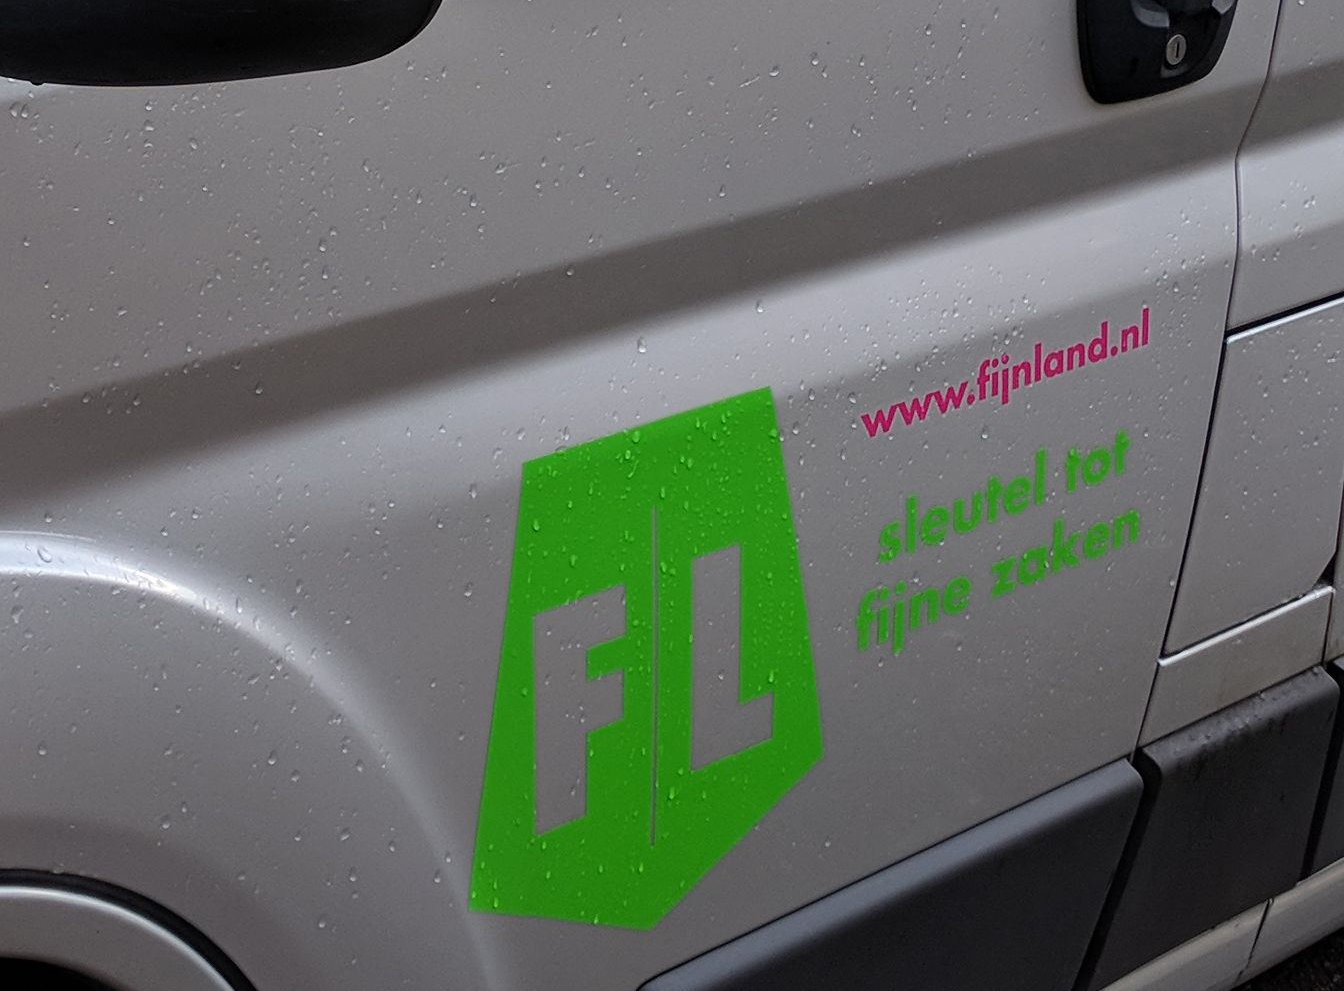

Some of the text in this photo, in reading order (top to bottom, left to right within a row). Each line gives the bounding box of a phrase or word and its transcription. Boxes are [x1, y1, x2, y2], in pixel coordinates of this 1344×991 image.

[861, 307, 1151, 439] www.fijnland.nl
[877, 430, 1131, 563] sleutel tot
[855, 505, 1140, 655] fijne zaken
